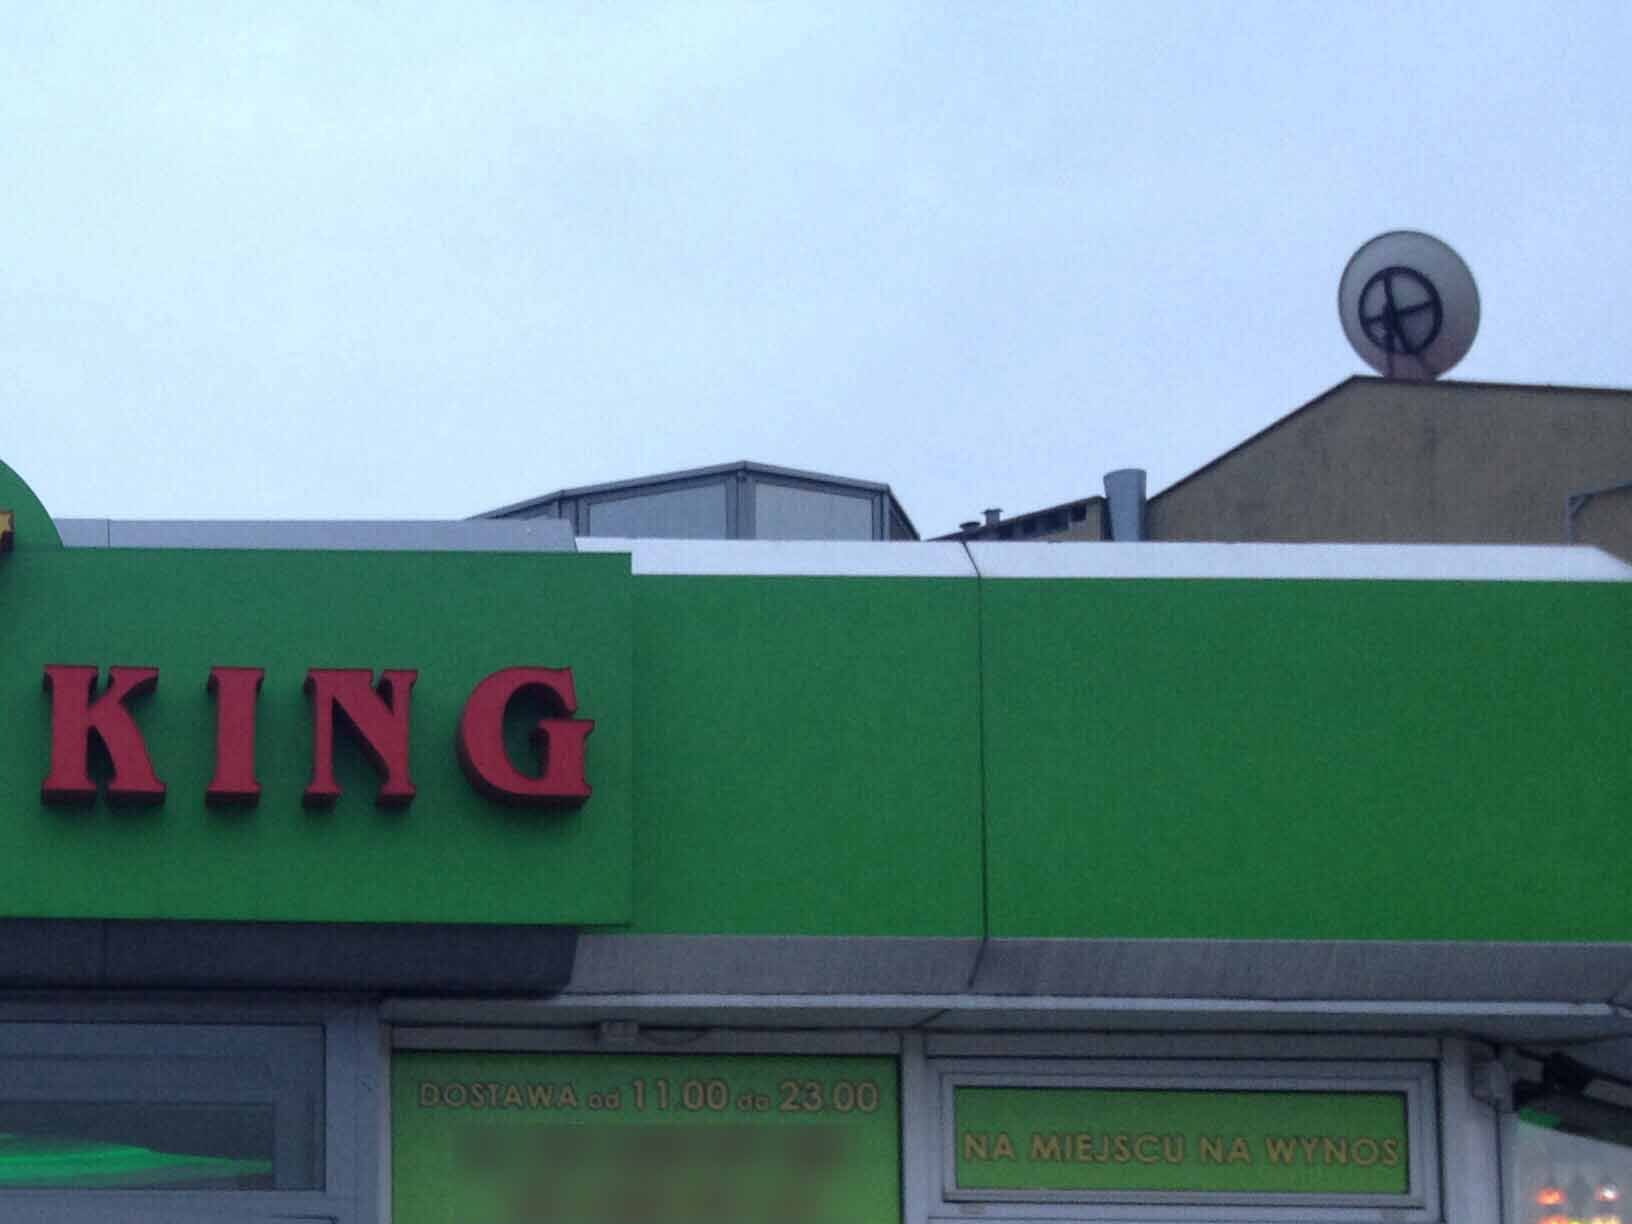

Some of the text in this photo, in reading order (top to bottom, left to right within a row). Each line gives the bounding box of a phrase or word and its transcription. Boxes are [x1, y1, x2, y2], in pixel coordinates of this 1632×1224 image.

[41, 664, 594, 804] KING
[419, 1082, 578, 1109] DOSTAWA
[588, 1089, 621, 1110] od
[736, 1088, 771, 1111] do
[963, 1131, 1400, 1168] NA MIEJSCU NA WYNOS
